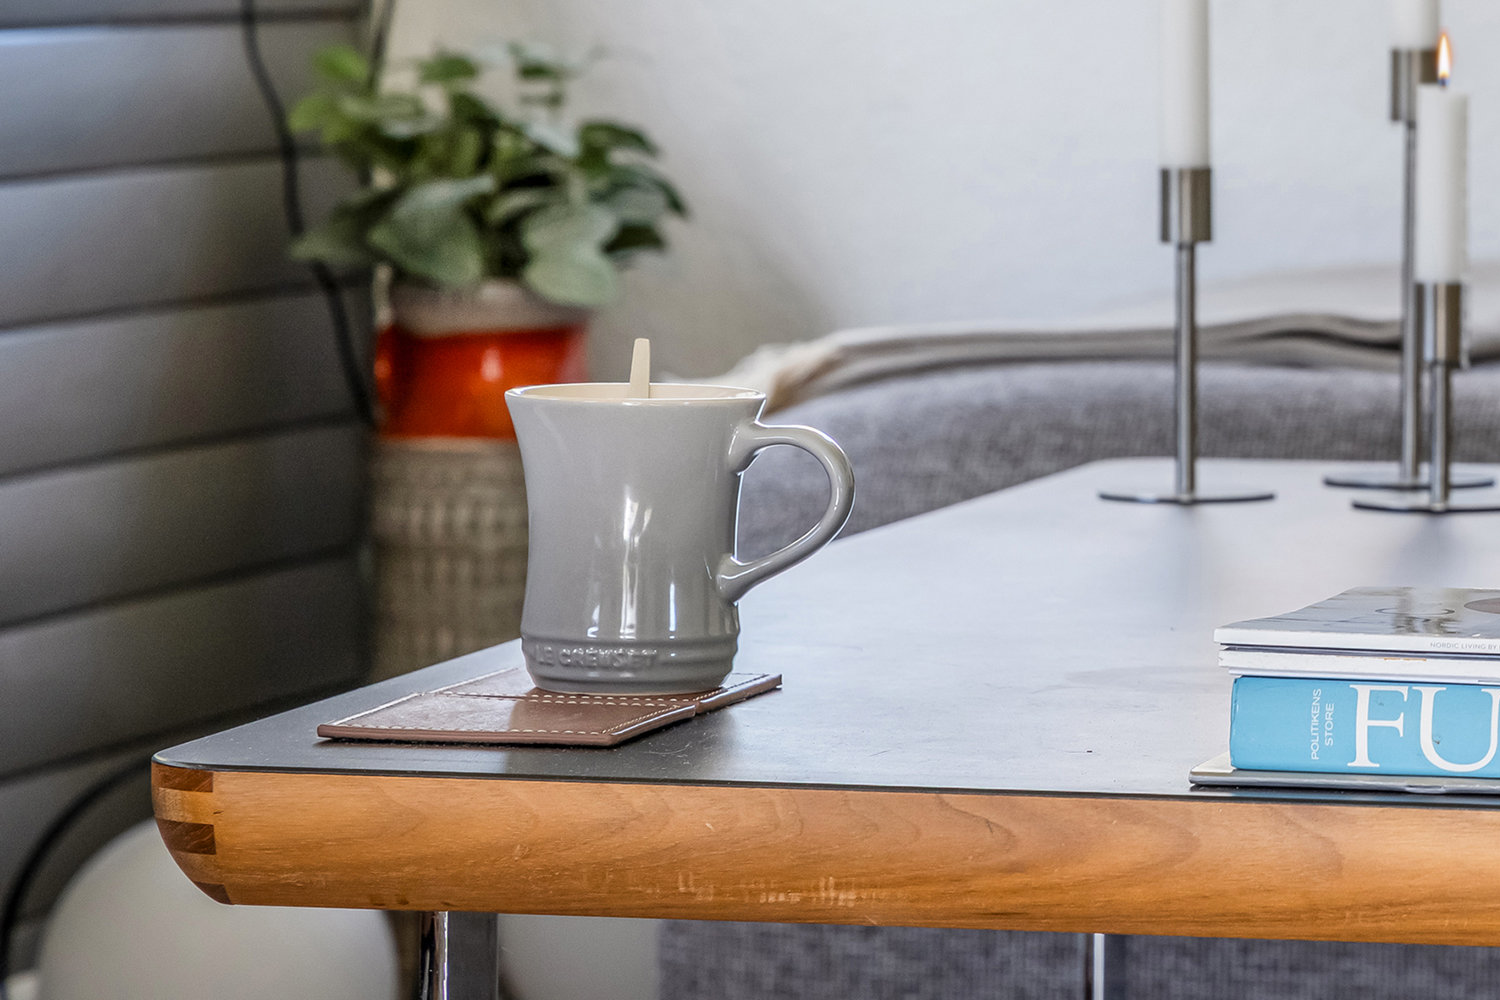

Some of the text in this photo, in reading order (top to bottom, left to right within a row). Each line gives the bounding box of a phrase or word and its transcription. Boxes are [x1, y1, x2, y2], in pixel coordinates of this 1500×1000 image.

[535, 644, 658, 670] LE CREUSET
[1310, 688, 1322, 760] POLITIKENS
[1324, 703, 1335, 747] STORE
